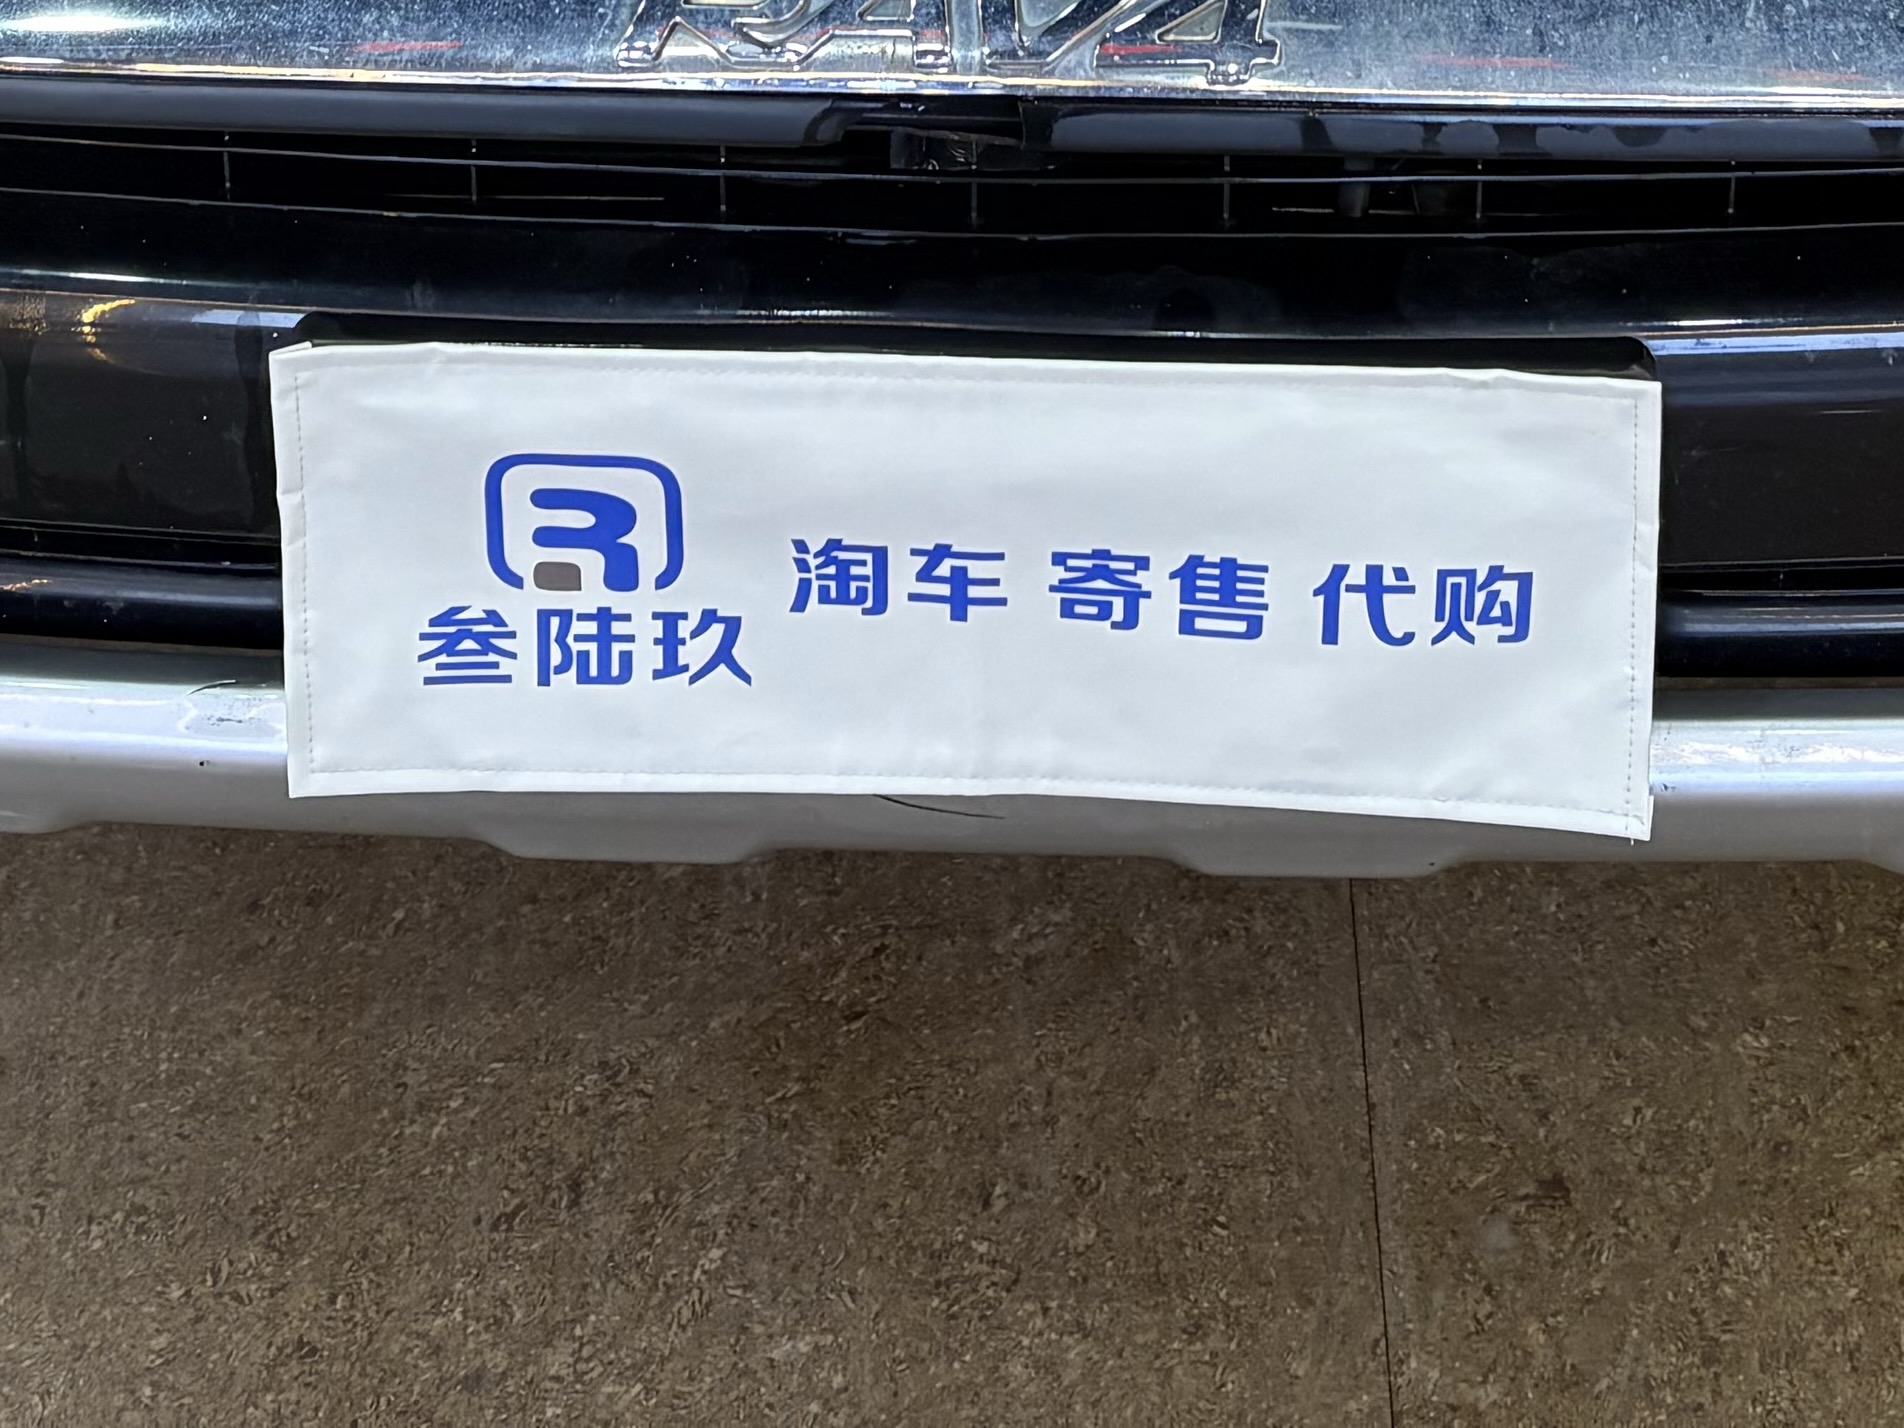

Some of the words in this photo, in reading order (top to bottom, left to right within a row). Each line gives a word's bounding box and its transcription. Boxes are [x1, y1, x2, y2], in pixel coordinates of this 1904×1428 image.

[790, 538, 1008, 622] 淘车
[1048, 547, 1268, 640] 寄售
[1312, 563, 1533, 646] 代购
[418, 605, 753, 687] 叁陆玖
